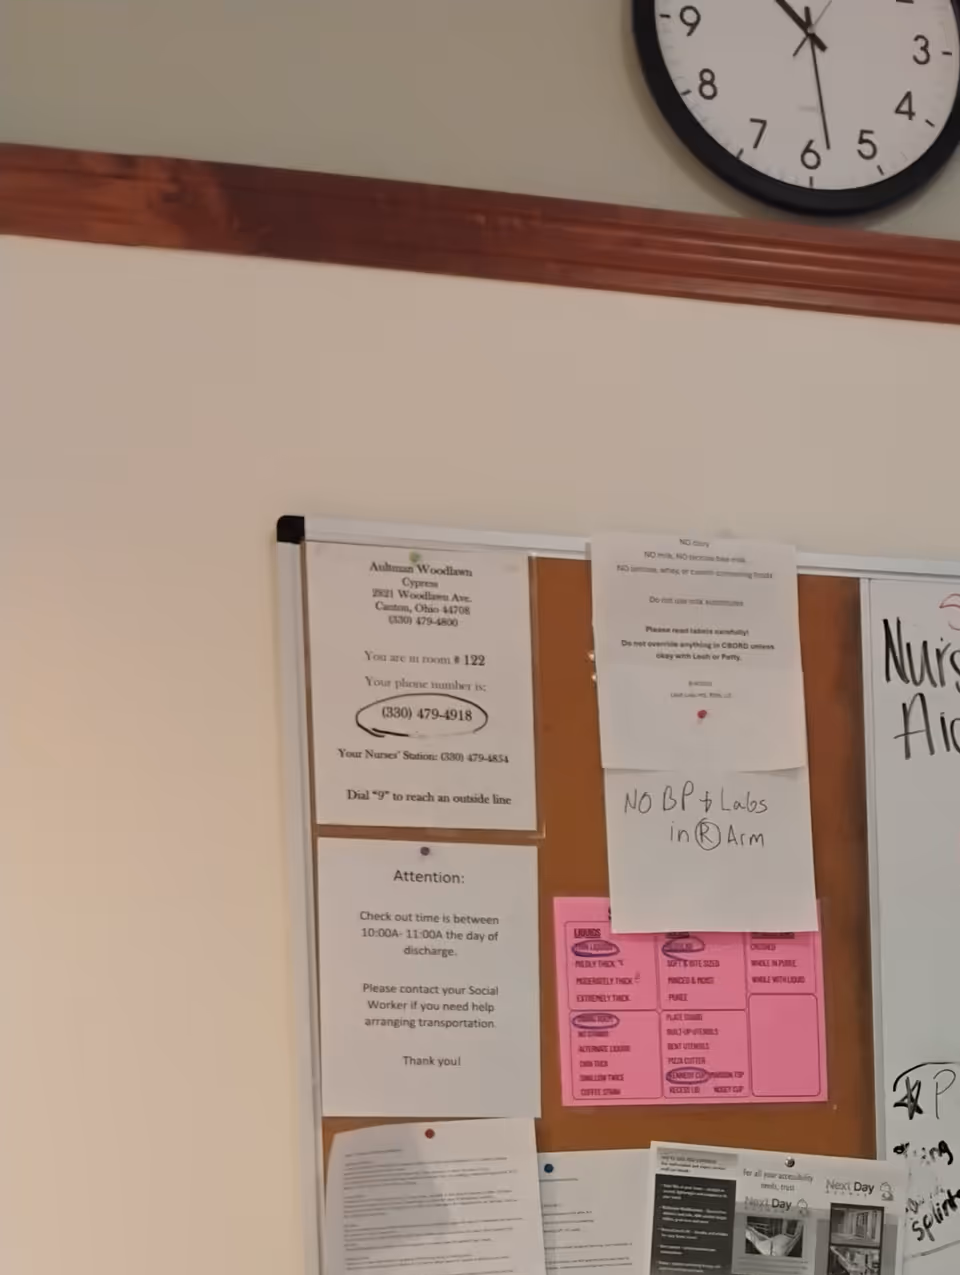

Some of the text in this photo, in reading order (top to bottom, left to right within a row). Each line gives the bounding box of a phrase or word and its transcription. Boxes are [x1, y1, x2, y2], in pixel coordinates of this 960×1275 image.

[679, 5, 701, 36] 9
[913, 35, 931, 65] 3
[698, 68, 718, 100] 8
[895, 91, 916, 121] 4
[749, 118, 768, 149] 7
[856, 129, 878, 160] 5
[800, 139, 821, 170] 6
[417, 564, 473, 577] Woodlawn
[397, 589, 449, 601] Woodlawn
[414, 603, 440, 613] Ohio
[634, 640, 646, 648] not
[364, 650, 387, 661] You
[390, 653, 406, 663] are
[409, 655, 419, 663] in
[422, 656, 451, 664] room
[464, 655, 486, 666] 122
[364, 676, 391, 687] Your
[395, 678, 429, 690] phone
[431, 680, 471, 691] number
[382, 706, 473, 722] (330) 479-4918
[338, 748, 363, 759] Your
[402, 750, 438, 761] Station:
[440, 752, 464, 763] (330)
[347, 789, 370, 800] Dial
[392, 793, 404, 801] to
[405, 792, 434, 803] reach
[437, 795, 450, 803] an
[452, 794, 490, 805] outside
[492, 794, 512, 805] line
[624, 788, 652, 814] NO
[662, 780, 695, 812] BP
[721, 786, 768, 814] Labs
[727, 824, 765, 847] Arm
[393, 870, 465, 884] Attention:
[360, 911, 500, 925] Check out time is between
[406, 929, 443, 940] 11:00A
[446, 930, 463, 940] the
[466, 931, 485, 943] day
[488, 932, 499, 941] of
[403, 946, 458, 958] discharge.
[363, 982, 499, 996] Please contact your Social
[368, 1000, 495, 1014] Worker if you need help
[365, 1018, 416, 1029] arranging
[402, 1055, 461, 1068] Thank you!
[853, 1181, 875, 1195] Day
[771, 1198, 792, 1212] Day
